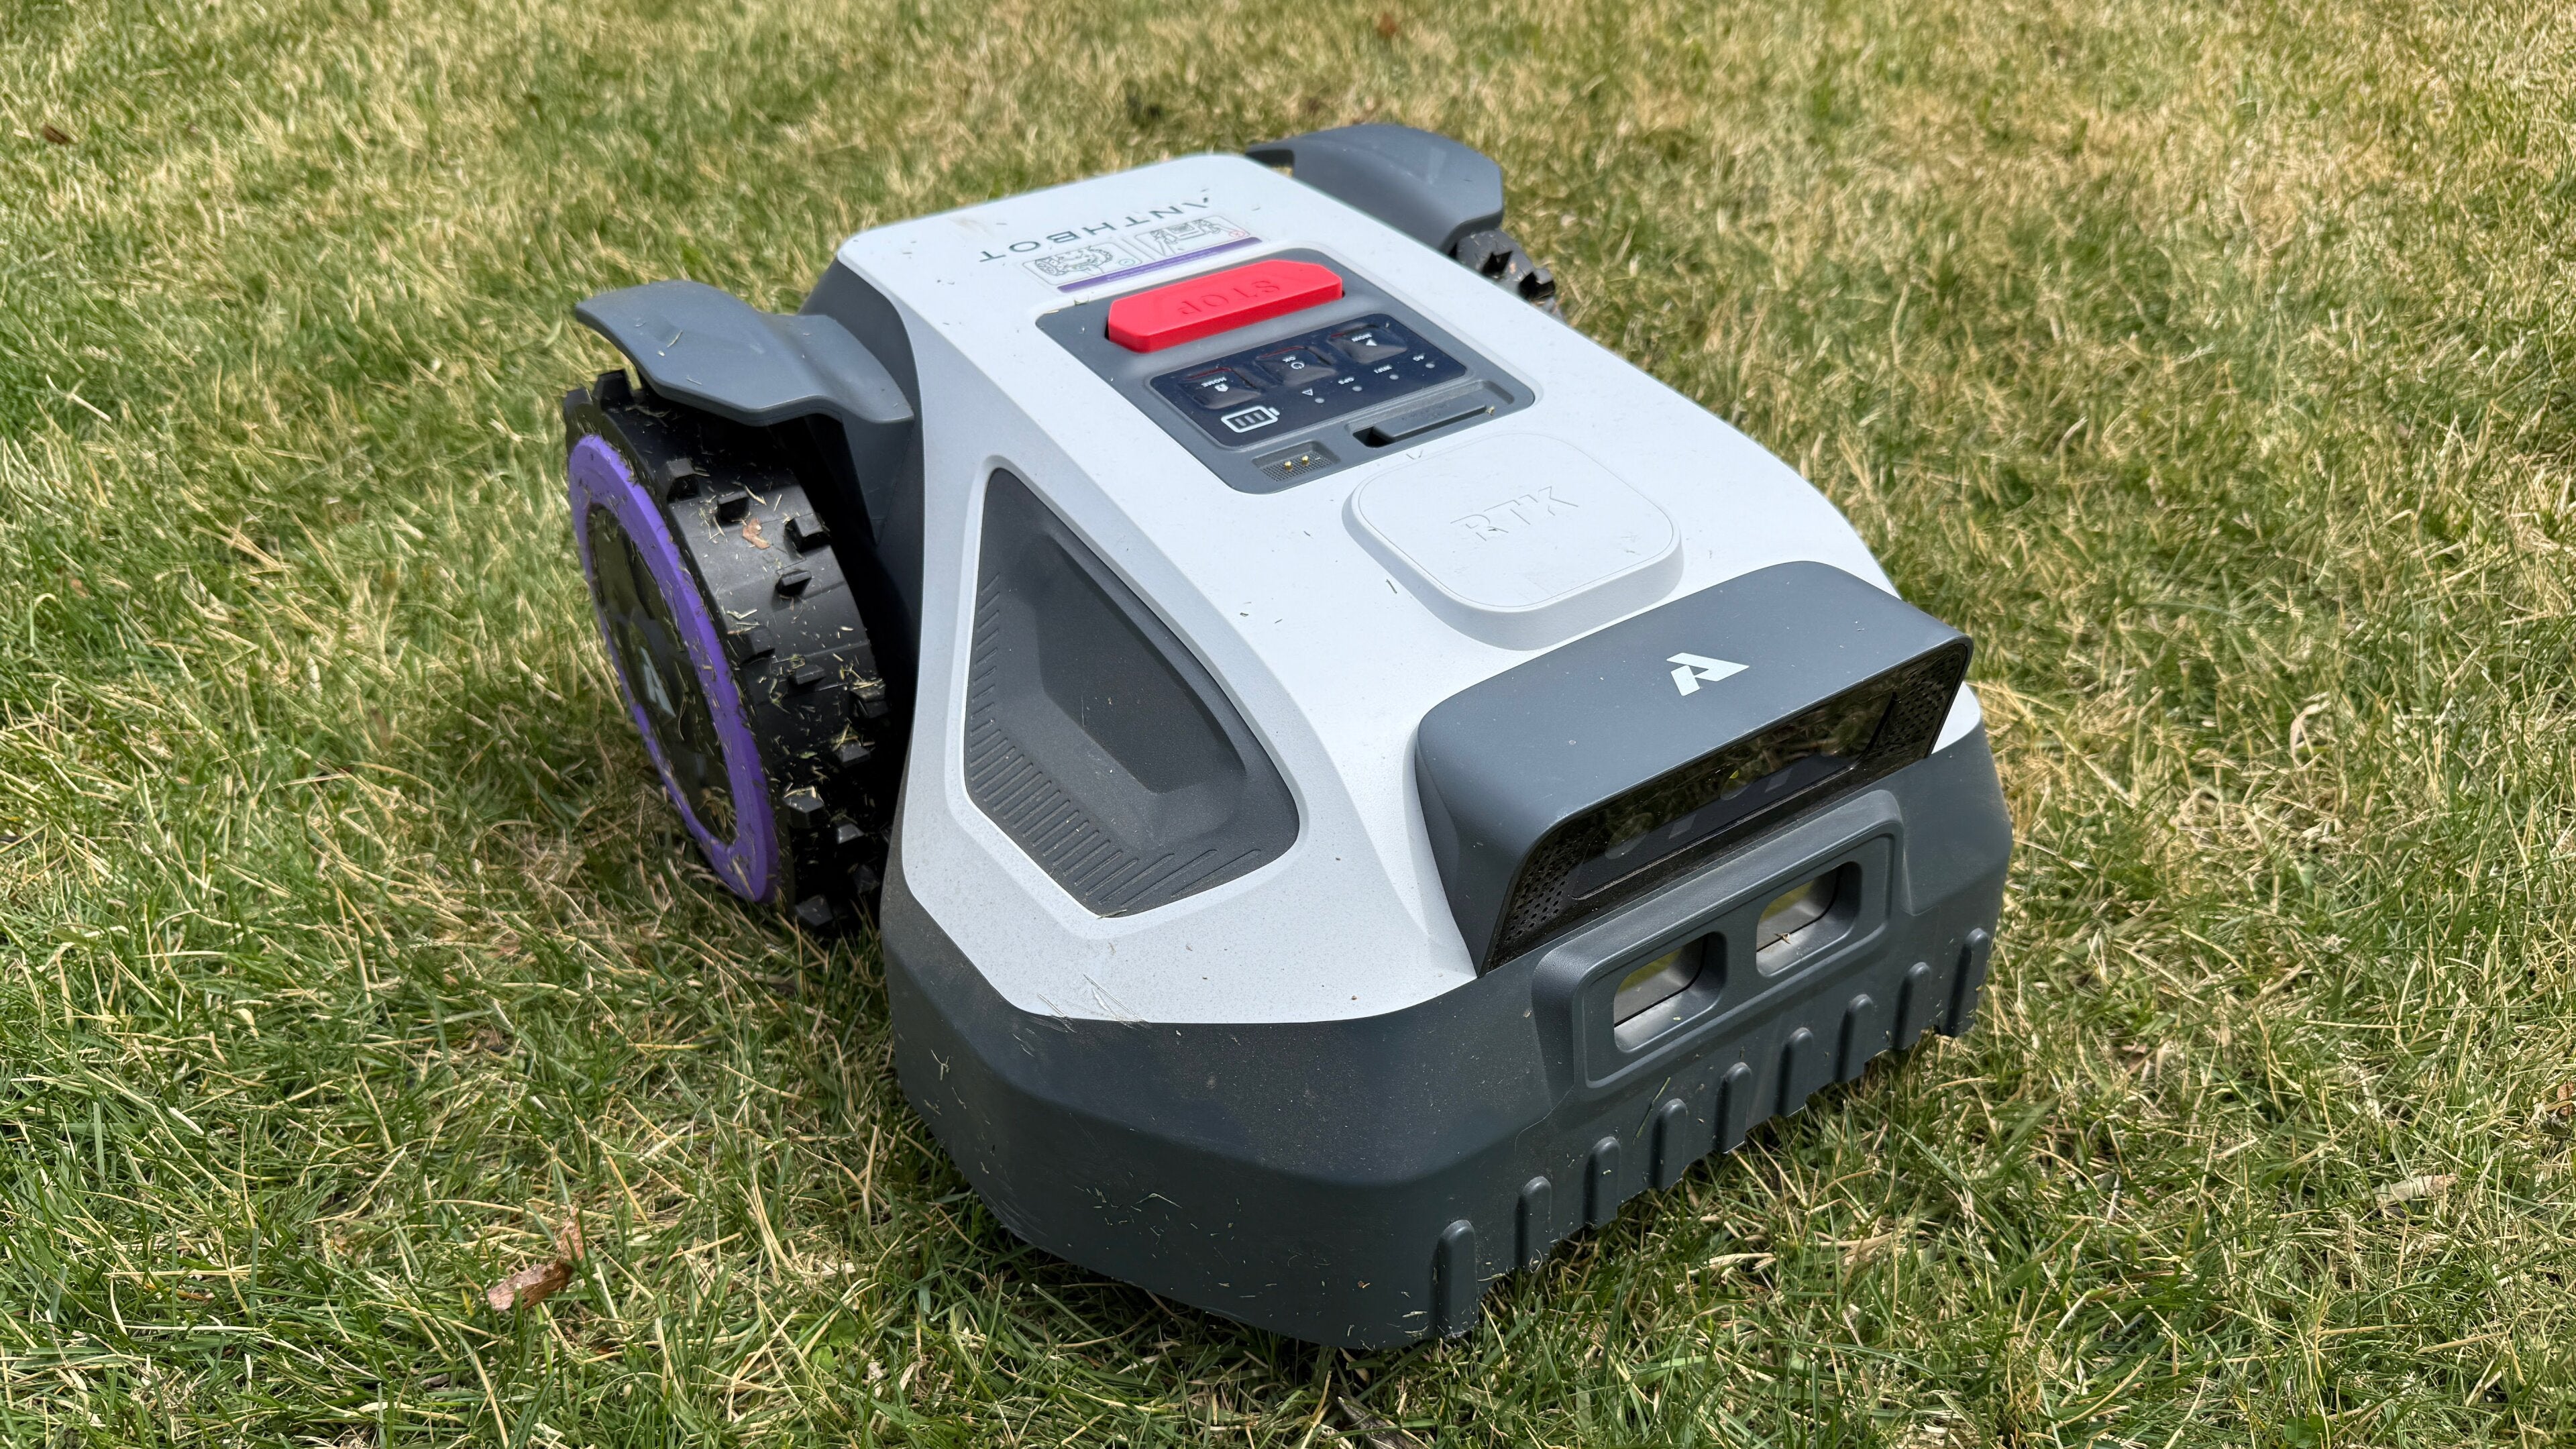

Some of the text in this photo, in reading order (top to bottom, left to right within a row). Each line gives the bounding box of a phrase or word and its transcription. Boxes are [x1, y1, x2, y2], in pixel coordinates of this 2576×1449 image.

[979, 197, 1210, 263] ANTHBOT
[1176, 280, 1281, 313] STOP
[1352, 333, 1373, 343] MOW
[1282, 356, 1297, 364] OK
[1413, 354, 1426, 362] 4G
[1200, 376, 1227, 388] HOME
[1338, 376, 1355, 385] GPS
